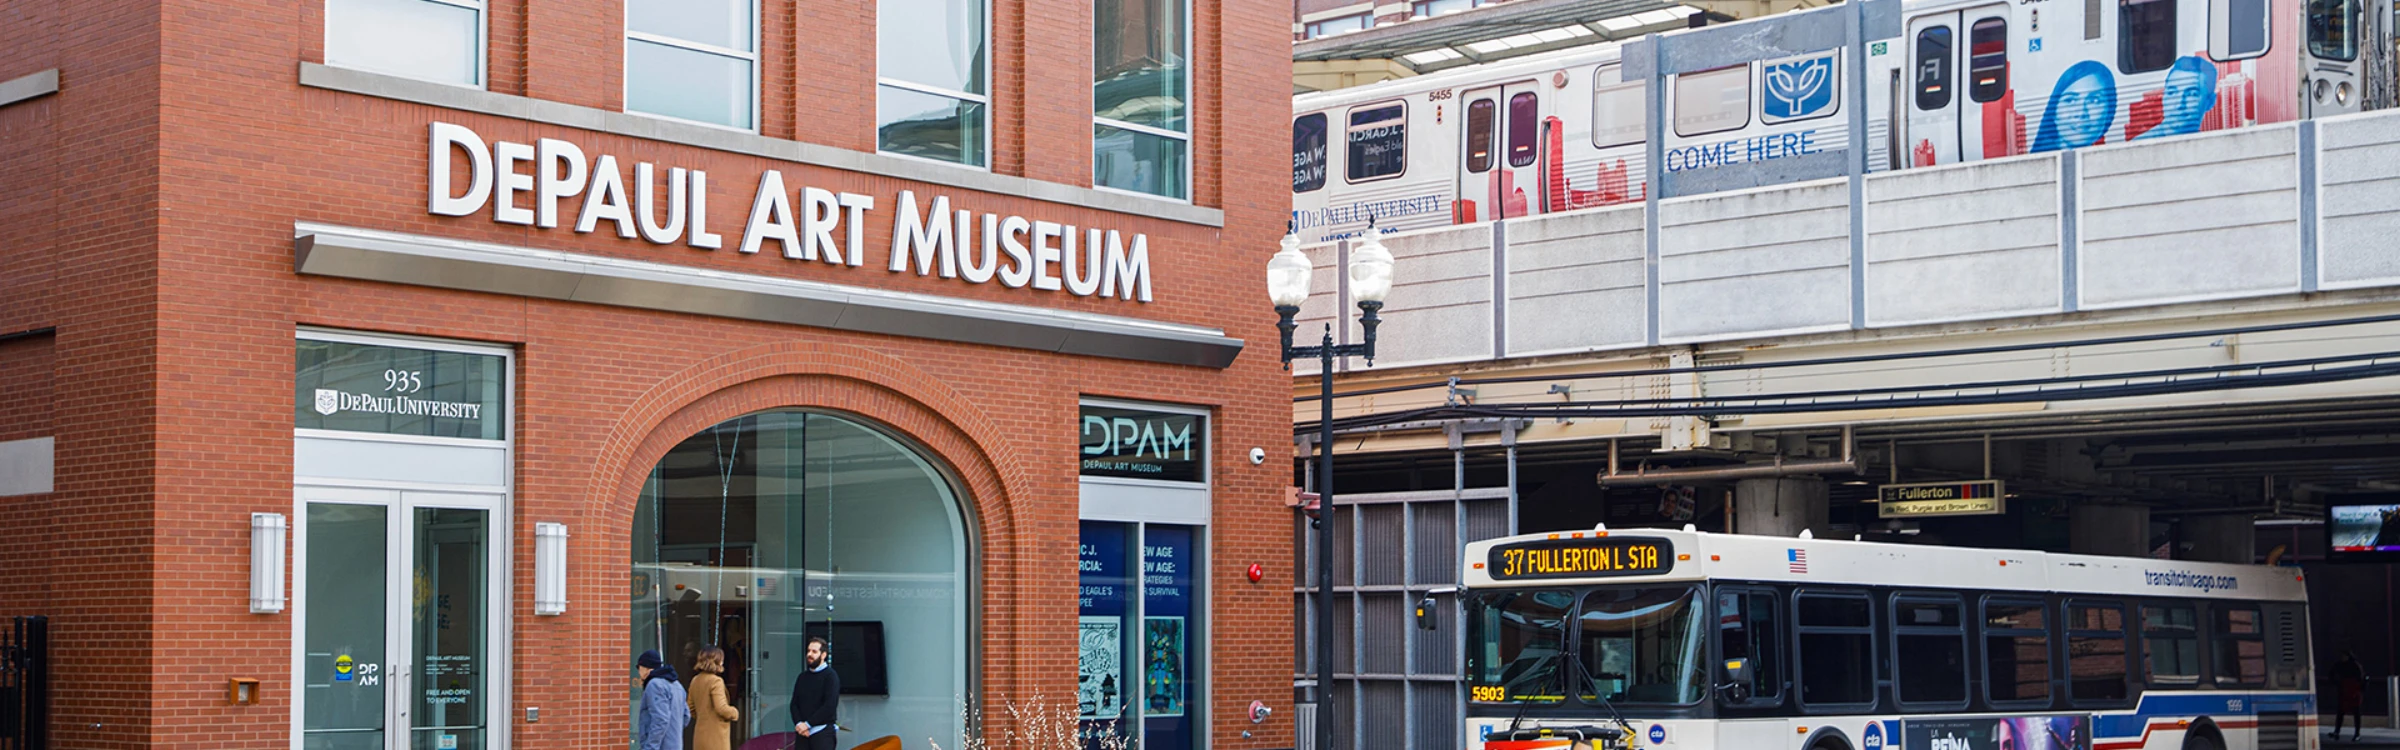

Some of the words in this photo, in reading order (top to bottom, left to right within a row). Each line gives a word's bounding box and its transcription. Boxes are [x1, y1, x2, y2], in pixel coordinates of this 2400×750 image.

[1428, 88, 1452, 102] 5455
[1667, 140, 1739, 173] COME
[1746, 130, 1823, 162] HERE.
[428, 121, 722, 250] DEPAUL
[739, 169, 874, 267] ART
[888, 189, 1153, 303] MUSEUM
[1353, 194, 1442, 222] UNIVERSITY
[384, 368, 422, 394] 935
[339, 391, 397, 414] DEPAUL
[396, 395, 482, 420] UNIVERSITY
[1084, 415, 1190, 461] DPAM
[1083, 459, 1113, 471] DEPAUL
[1114, 462, 1129, 471] ART
[1130, 463, 1162, 473] MUSEUM
[1898, 486, 1953, 500] Fullerton
[1934, 503, 1947, 511] and
[1948, 503, 1969, 511] Brown
[1088, 544, 1098, 556] J.
[1155, 546, 1174, 558] AGE
[1155, 561, 1176, 574] AGE:
[1503, 549, 1525, 576] 37
[1528, 547, 1609, 574] FULLERTON
[1613, 546, 1624, 570] L
[1628, 545, 1658, 570] STA
[2144, 569, 2238, 593] transitchicago.com
[1085, 586, 1113, 597] EAGLE'S
[1148, 586, 1180, 597] SURVIVAL
[359, 663, 379, 675] DP
[359, 675, 379, 686] AM
[435, 696, 466, 704] EVERYONE
[1471, 685, 1505, 702] 5903
[1650, 729, 1664, 739] cta
[1865, 733, 1881, 747] cta
